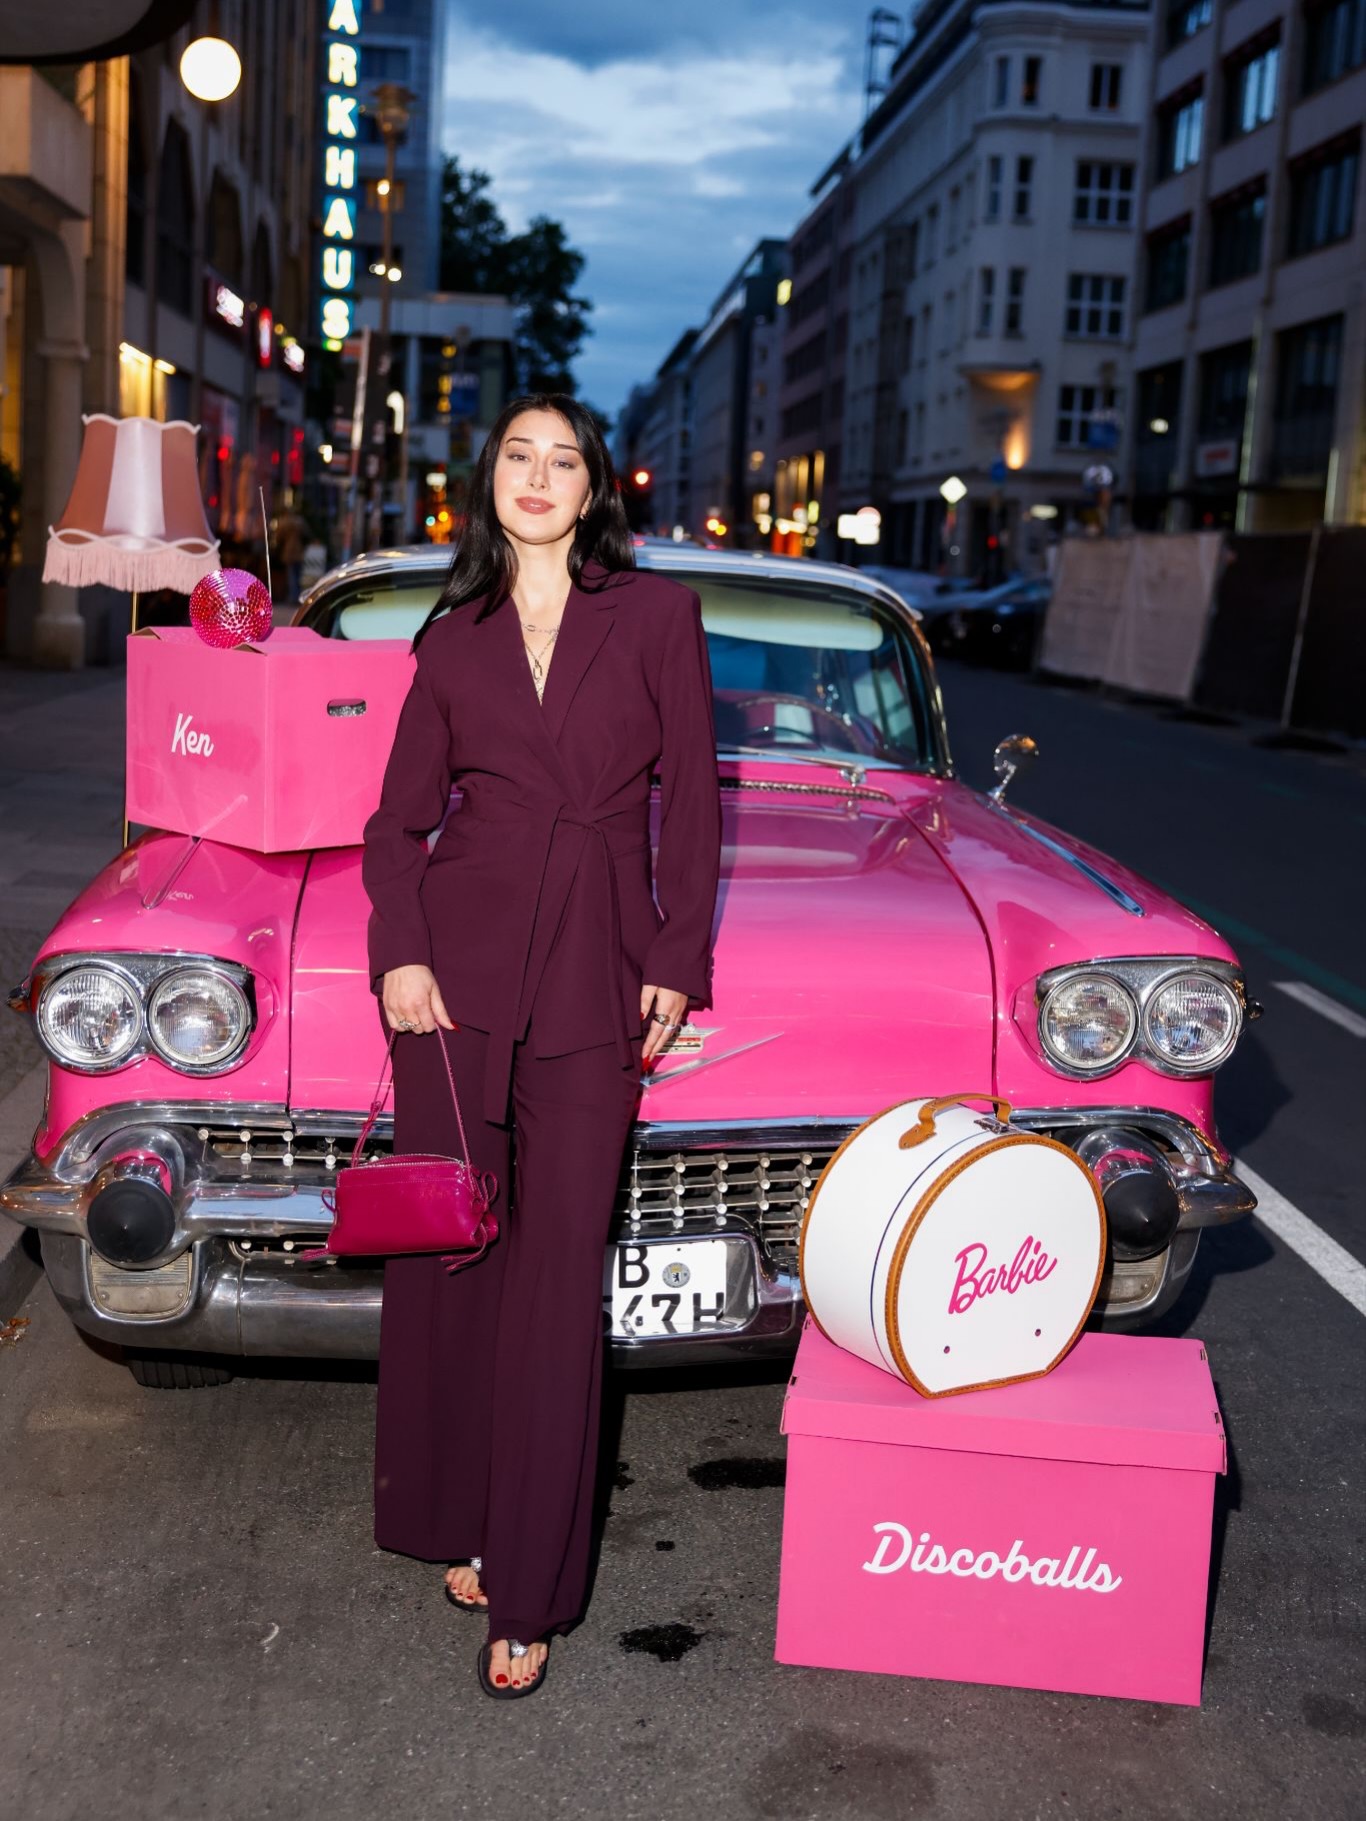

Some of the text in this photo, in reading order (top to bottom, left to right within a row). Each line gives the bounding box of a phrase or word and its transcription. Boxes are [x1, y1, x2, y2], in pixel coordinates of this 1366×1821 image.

[171, 712, 214, 757] Ken
[618, 1245, 650, 1288] B
[948, 1236, 1057, 1314] Barbie
[862, 1521, 1123, 1594] Discoballs
